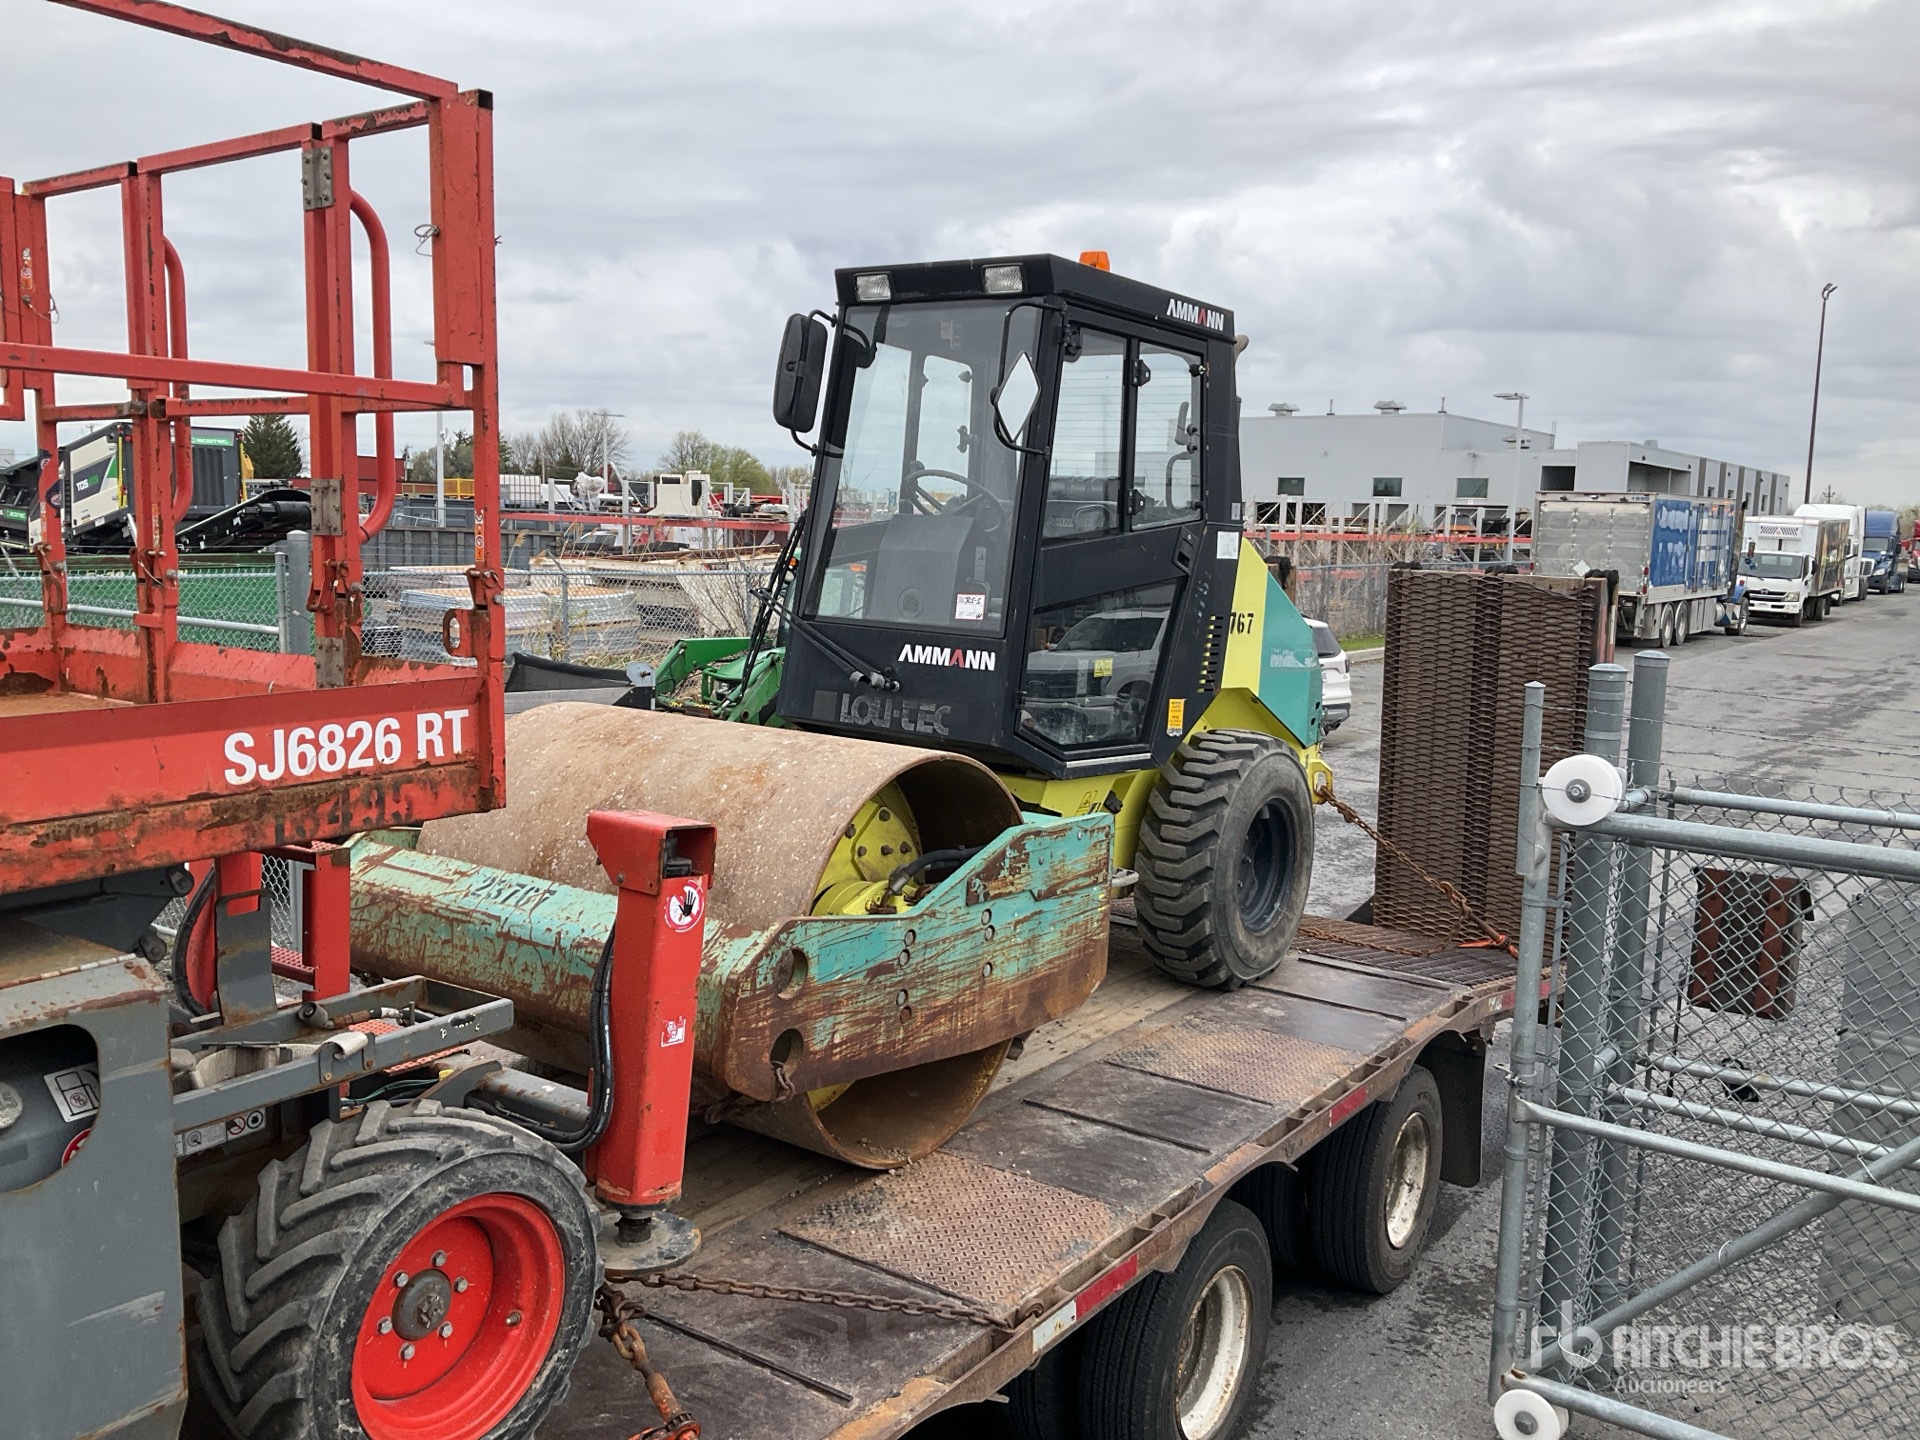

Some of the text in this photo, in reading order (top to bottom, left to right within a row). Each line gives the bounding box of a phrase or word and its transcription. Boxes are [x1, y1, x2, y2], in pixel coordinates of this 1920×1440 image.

[1166, 298, 1225, 331] AMMANN
[898, 643, 996, 671] AMMANN
[839, 692, 951, 736] LOU-TEC
[224, 708, 469, 786] SJ6826 RT
